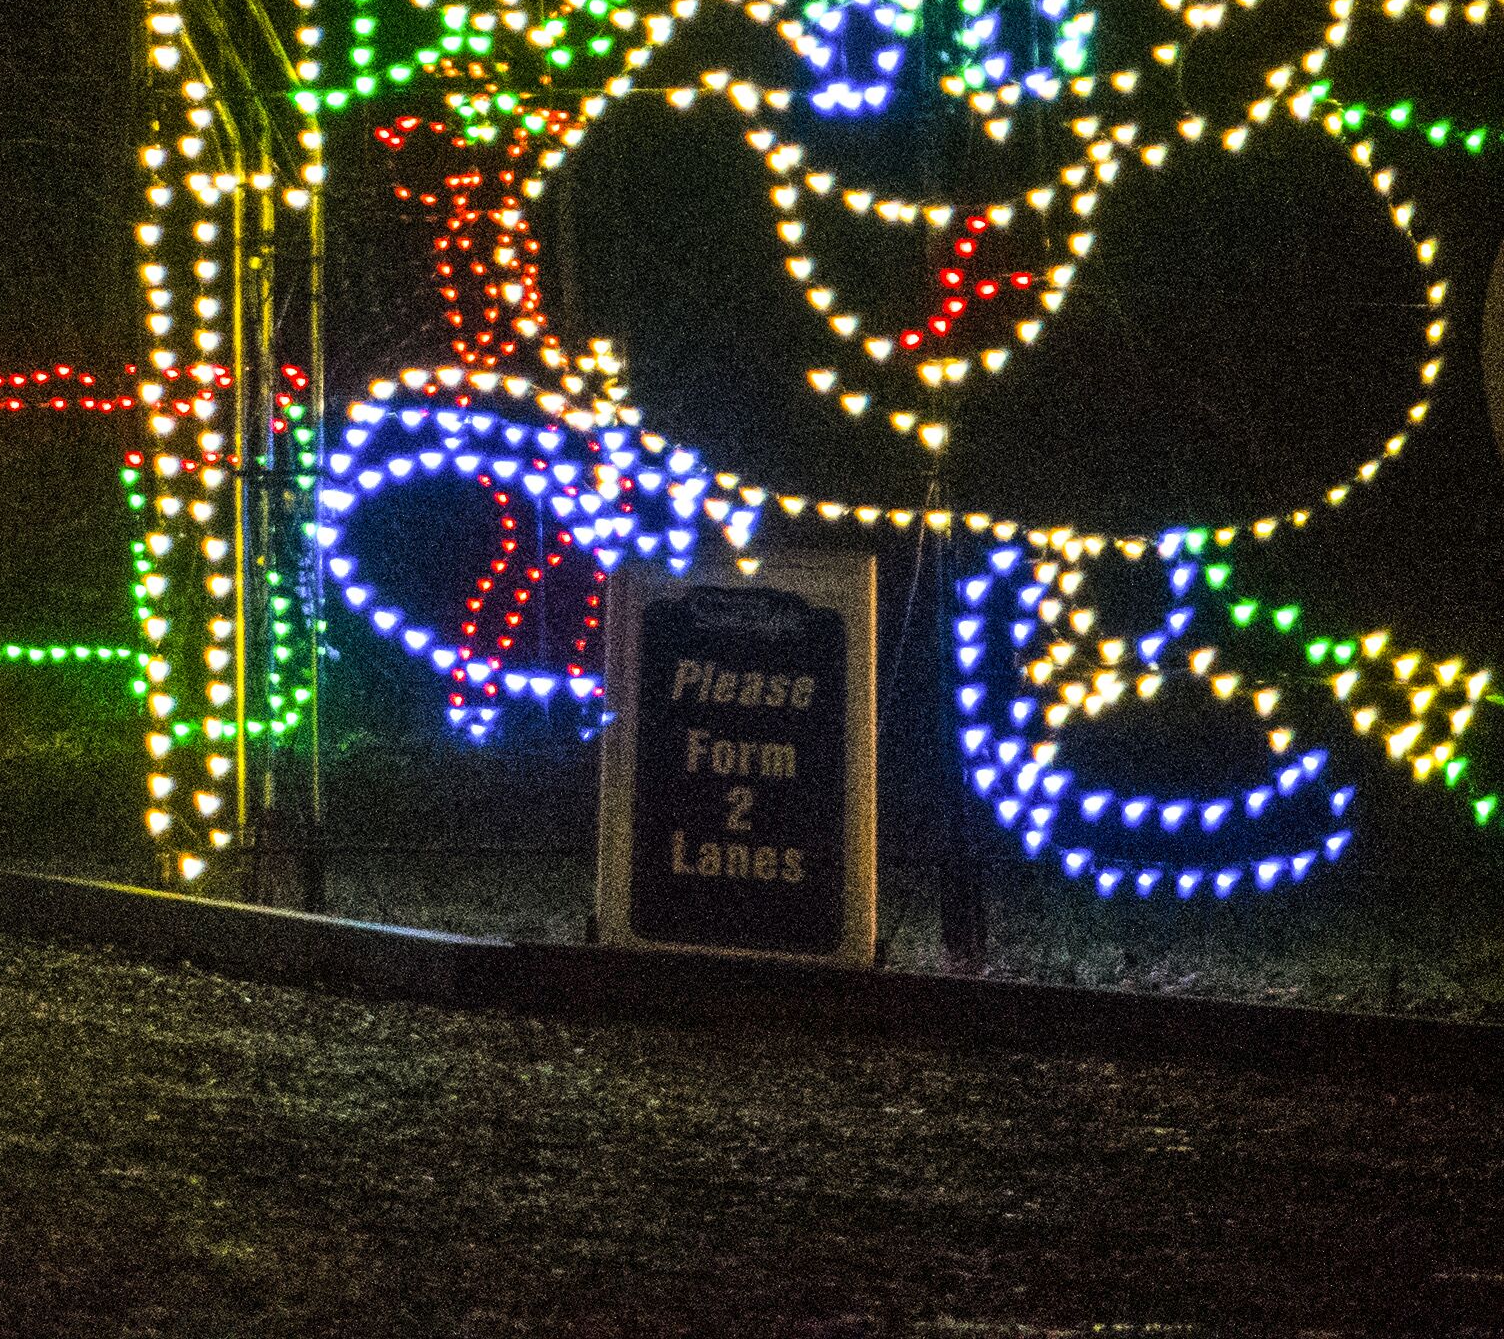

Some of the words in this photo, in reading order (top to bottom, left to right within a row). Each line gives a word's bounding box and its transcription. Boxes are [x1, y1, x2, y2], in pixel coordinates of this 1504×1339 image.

[671, 659, 816, 710] Please
[687, 729, 797, 779] Form
[725, 786, 755, 831] 2
[671, 830, 805, 883] Lanes
